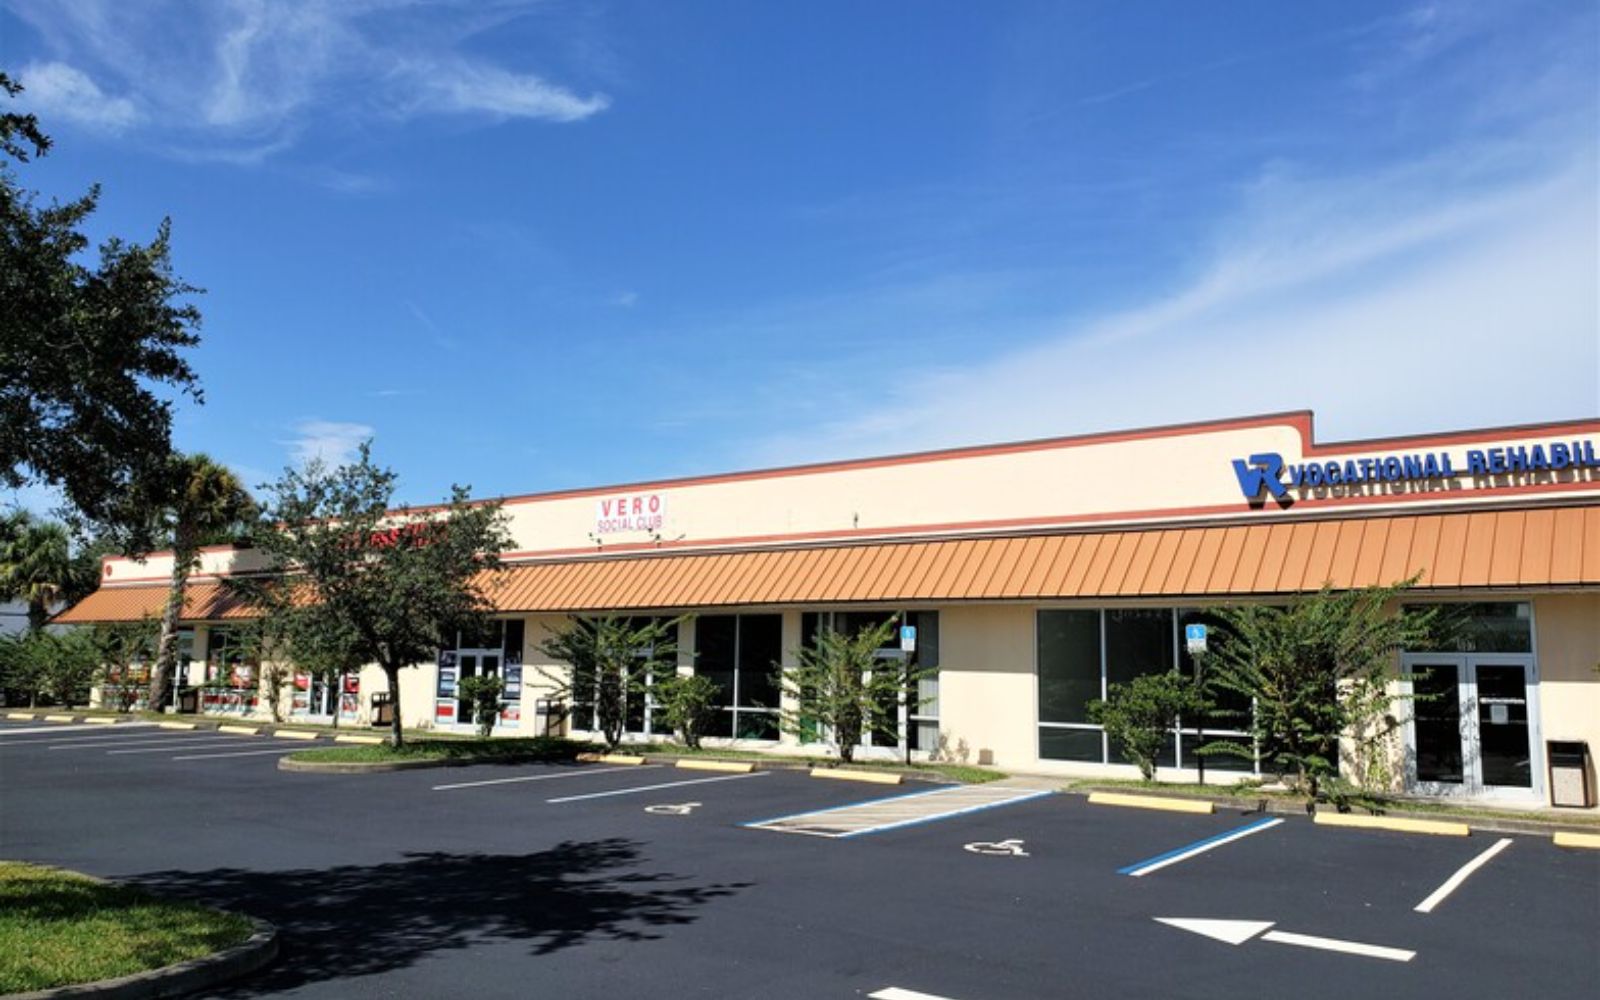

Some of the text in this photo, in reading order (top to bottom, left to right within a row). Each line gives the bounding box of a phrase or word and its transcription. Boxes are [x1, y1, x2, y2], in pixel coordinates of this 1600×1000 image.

[1232, 439, 1600, 498] VR VOCATIONAL REHABIL
[601, 494, 660, 517] VERO
[597, 514, 662, 533] SOCIAL CLUB
